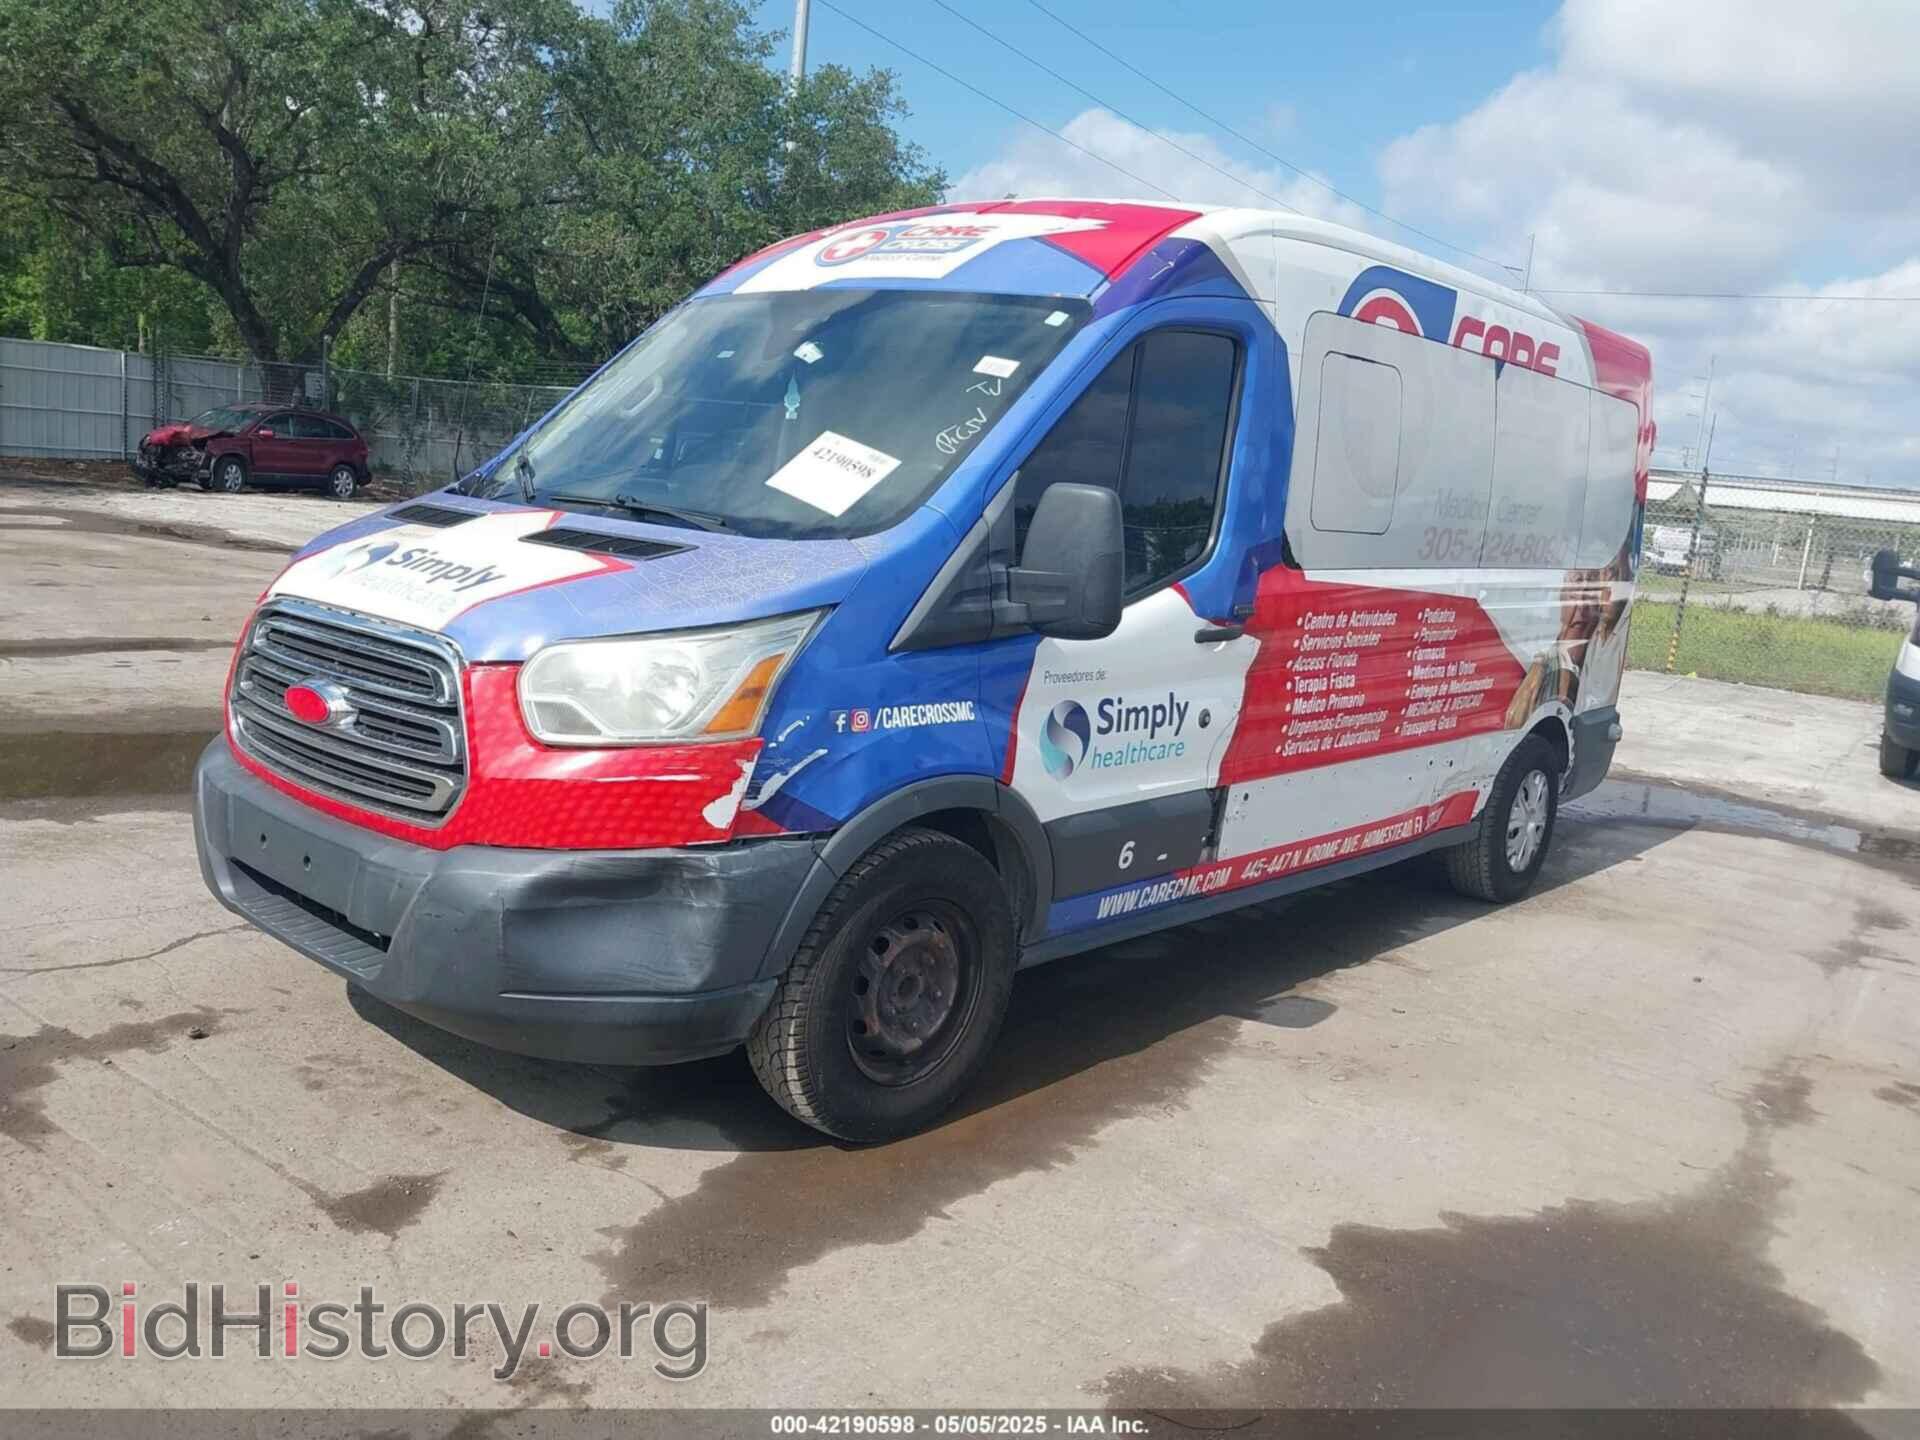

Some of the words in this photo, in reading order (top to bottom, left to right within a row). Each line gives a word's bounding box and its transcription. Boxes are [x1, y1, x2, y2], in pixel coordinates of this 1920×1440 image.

[386, 548, 507, 592] Simply
[1304, 612, 1335, 630] Centro
[1336, 611, 1348, 628] de
[1349, 610, 1397, 628] Actividades
[1301, 633, 1344, 651] Servicios
[1326, 652, 1358, 669] Florida
[1043, 670, 1094, 685] Proveedores
[1294, 674, 1328, 694] Terapia
[873, 700, 976, 730] /CARECROSSMC
[1327, 692, 1366, 711] Primario
[1096, 692, 1190, 740] Simply
[1091, 740, 1185, 769] healthcare
[1282, 737, 1319, 756] Servicio
[1320, 734, 1334, 750] de
[1334, 728, 1381, 748] Laboratorio
[1118, 840, 1136, 869] 6
[1096, 866, 1233, 920] WWW.CARECMC.COM
[1241, 851, 1292, 880] 445-447
